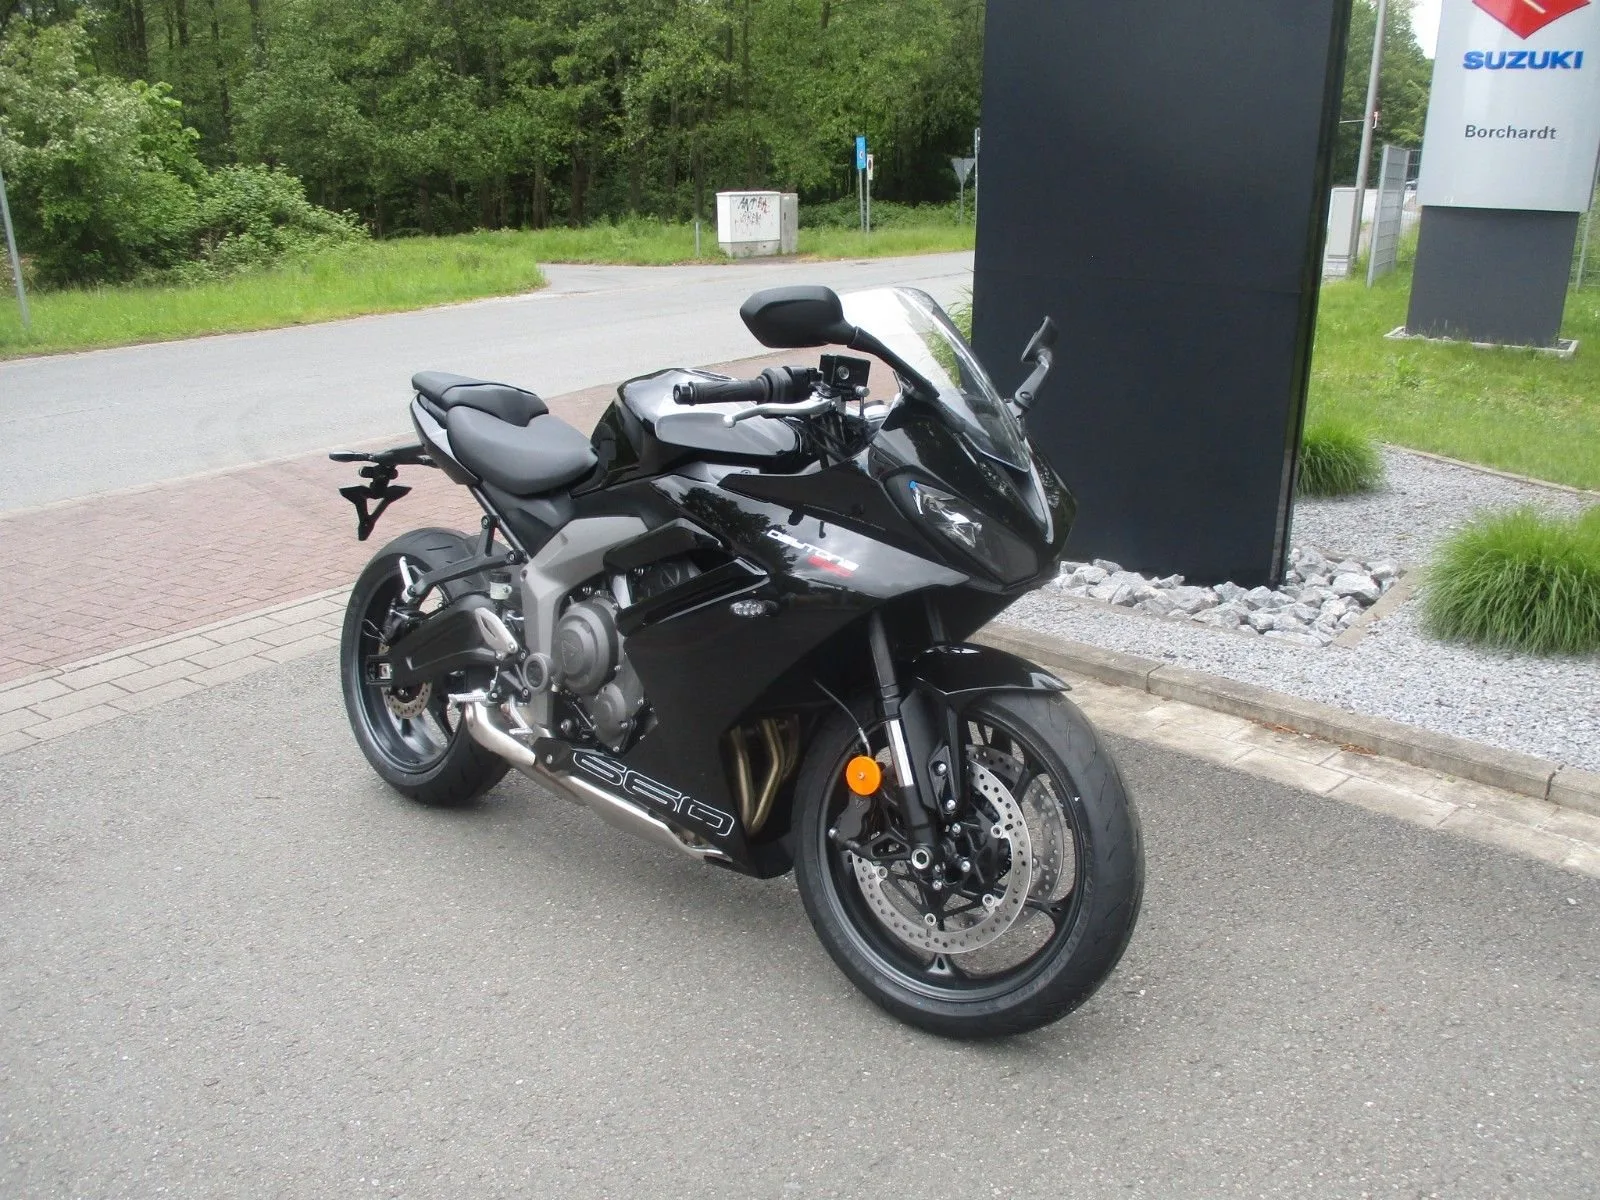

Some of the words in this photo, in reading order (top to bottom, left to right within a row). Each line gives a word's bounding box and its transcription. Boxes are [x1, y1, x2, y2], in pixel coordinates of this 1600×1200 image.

[1463, 51, 1584, 70] SUZUKI
[1465, 125, 1557, 140] Borchardt
[573, 752, 735, 837] 660
